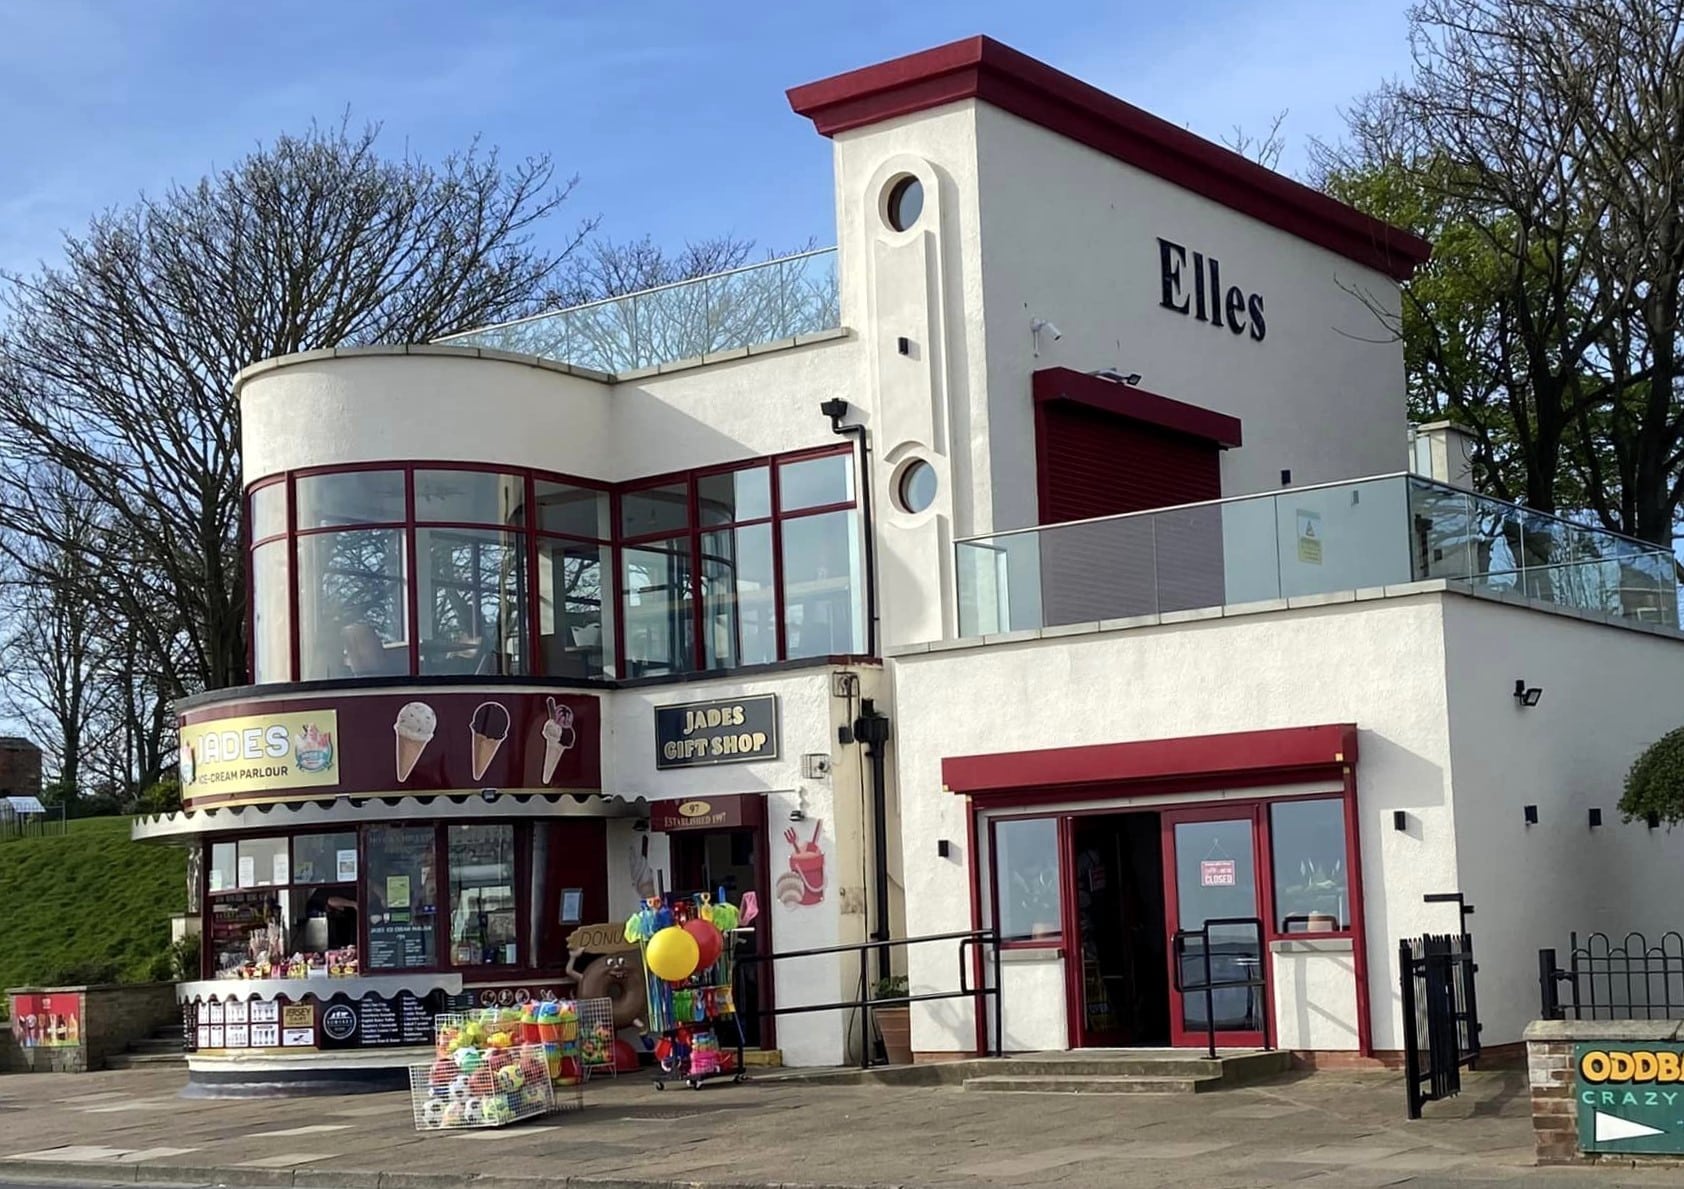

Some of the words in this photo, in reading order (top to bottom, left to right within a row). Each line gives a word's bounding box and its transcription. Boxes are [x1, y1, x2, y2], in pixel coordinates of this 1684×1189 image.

[1156, 236, 1266, 342] Elles
[682, 705, 745, 735] JADES
[196, 724, 289, 766] JADES
[663, 738, 708, 760] GIFT
[711, 731, 767, 755] SHOP
[198, 770, 238, 784] ICE-CREAM
[239, 766, 288, 779] PARLOUR
[664, 815, 711, 827] ESTABLISHED
[712, 811, 726, 824] 1997
[580, 930, 624, 947] DONU
[286, 1007, 312, 1017] JERSEY
[1581, 1090, 1678, 1106] CRAZY
